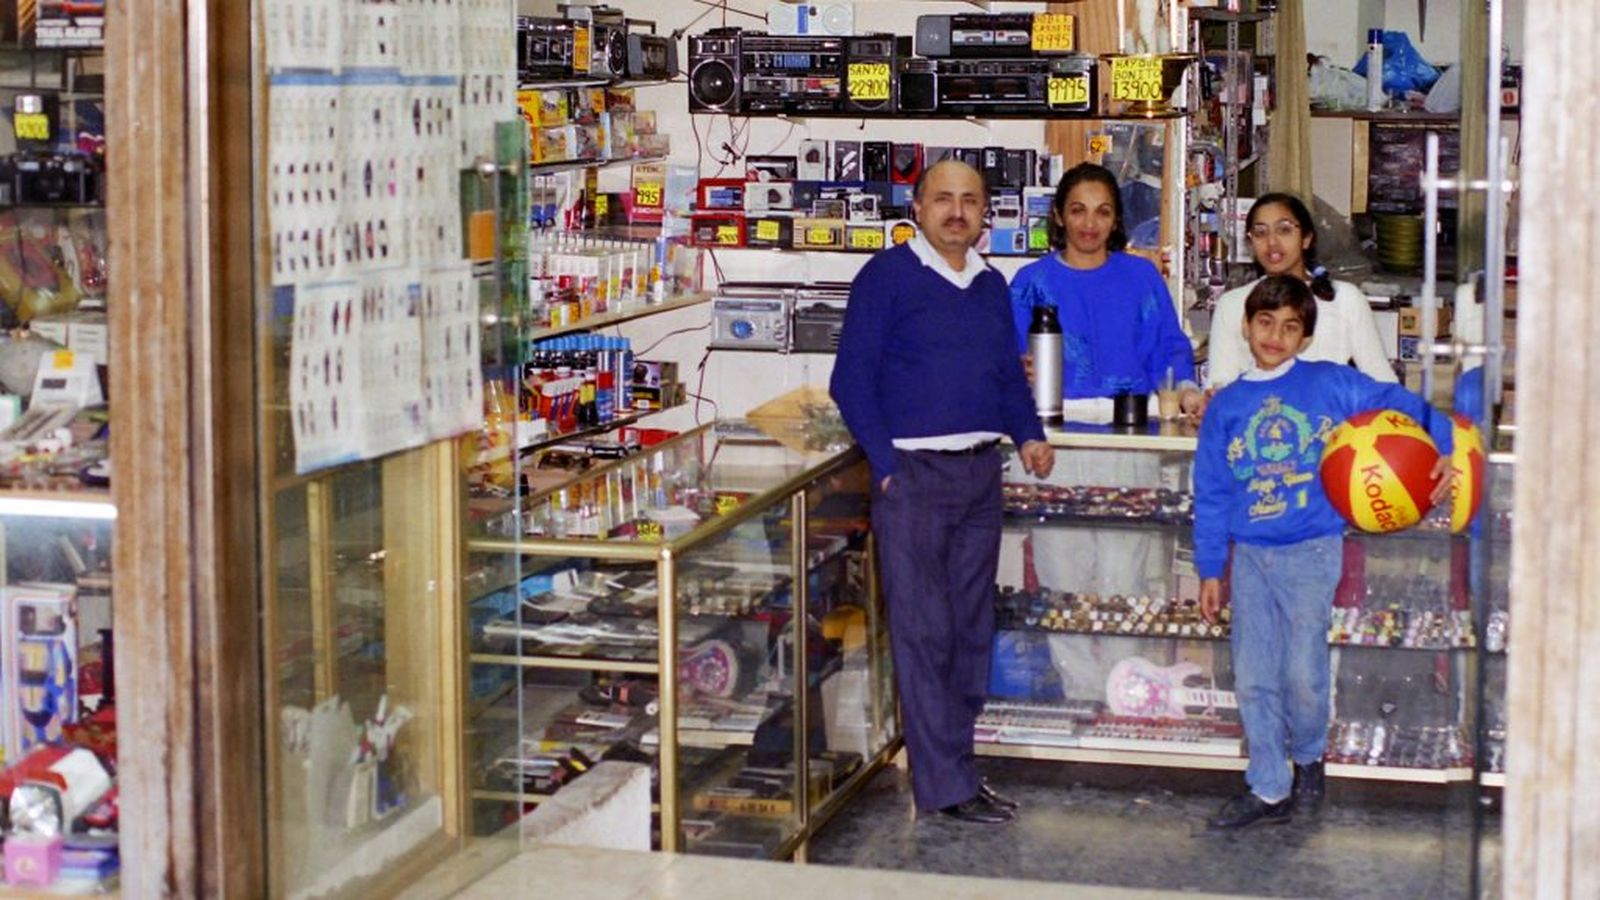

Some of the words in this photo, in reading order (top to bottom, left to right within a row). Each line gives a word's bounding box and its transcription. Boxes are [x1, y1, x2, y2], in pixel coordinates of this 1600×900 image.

[1036, 34, 1070, 48] 9995
[850, 65, 886, 75] SANYO
[850, 79, 888, 96] 22900
[1050, 79, 1086, 100] 9995
[1113, 80, 1161, 99] 13900
